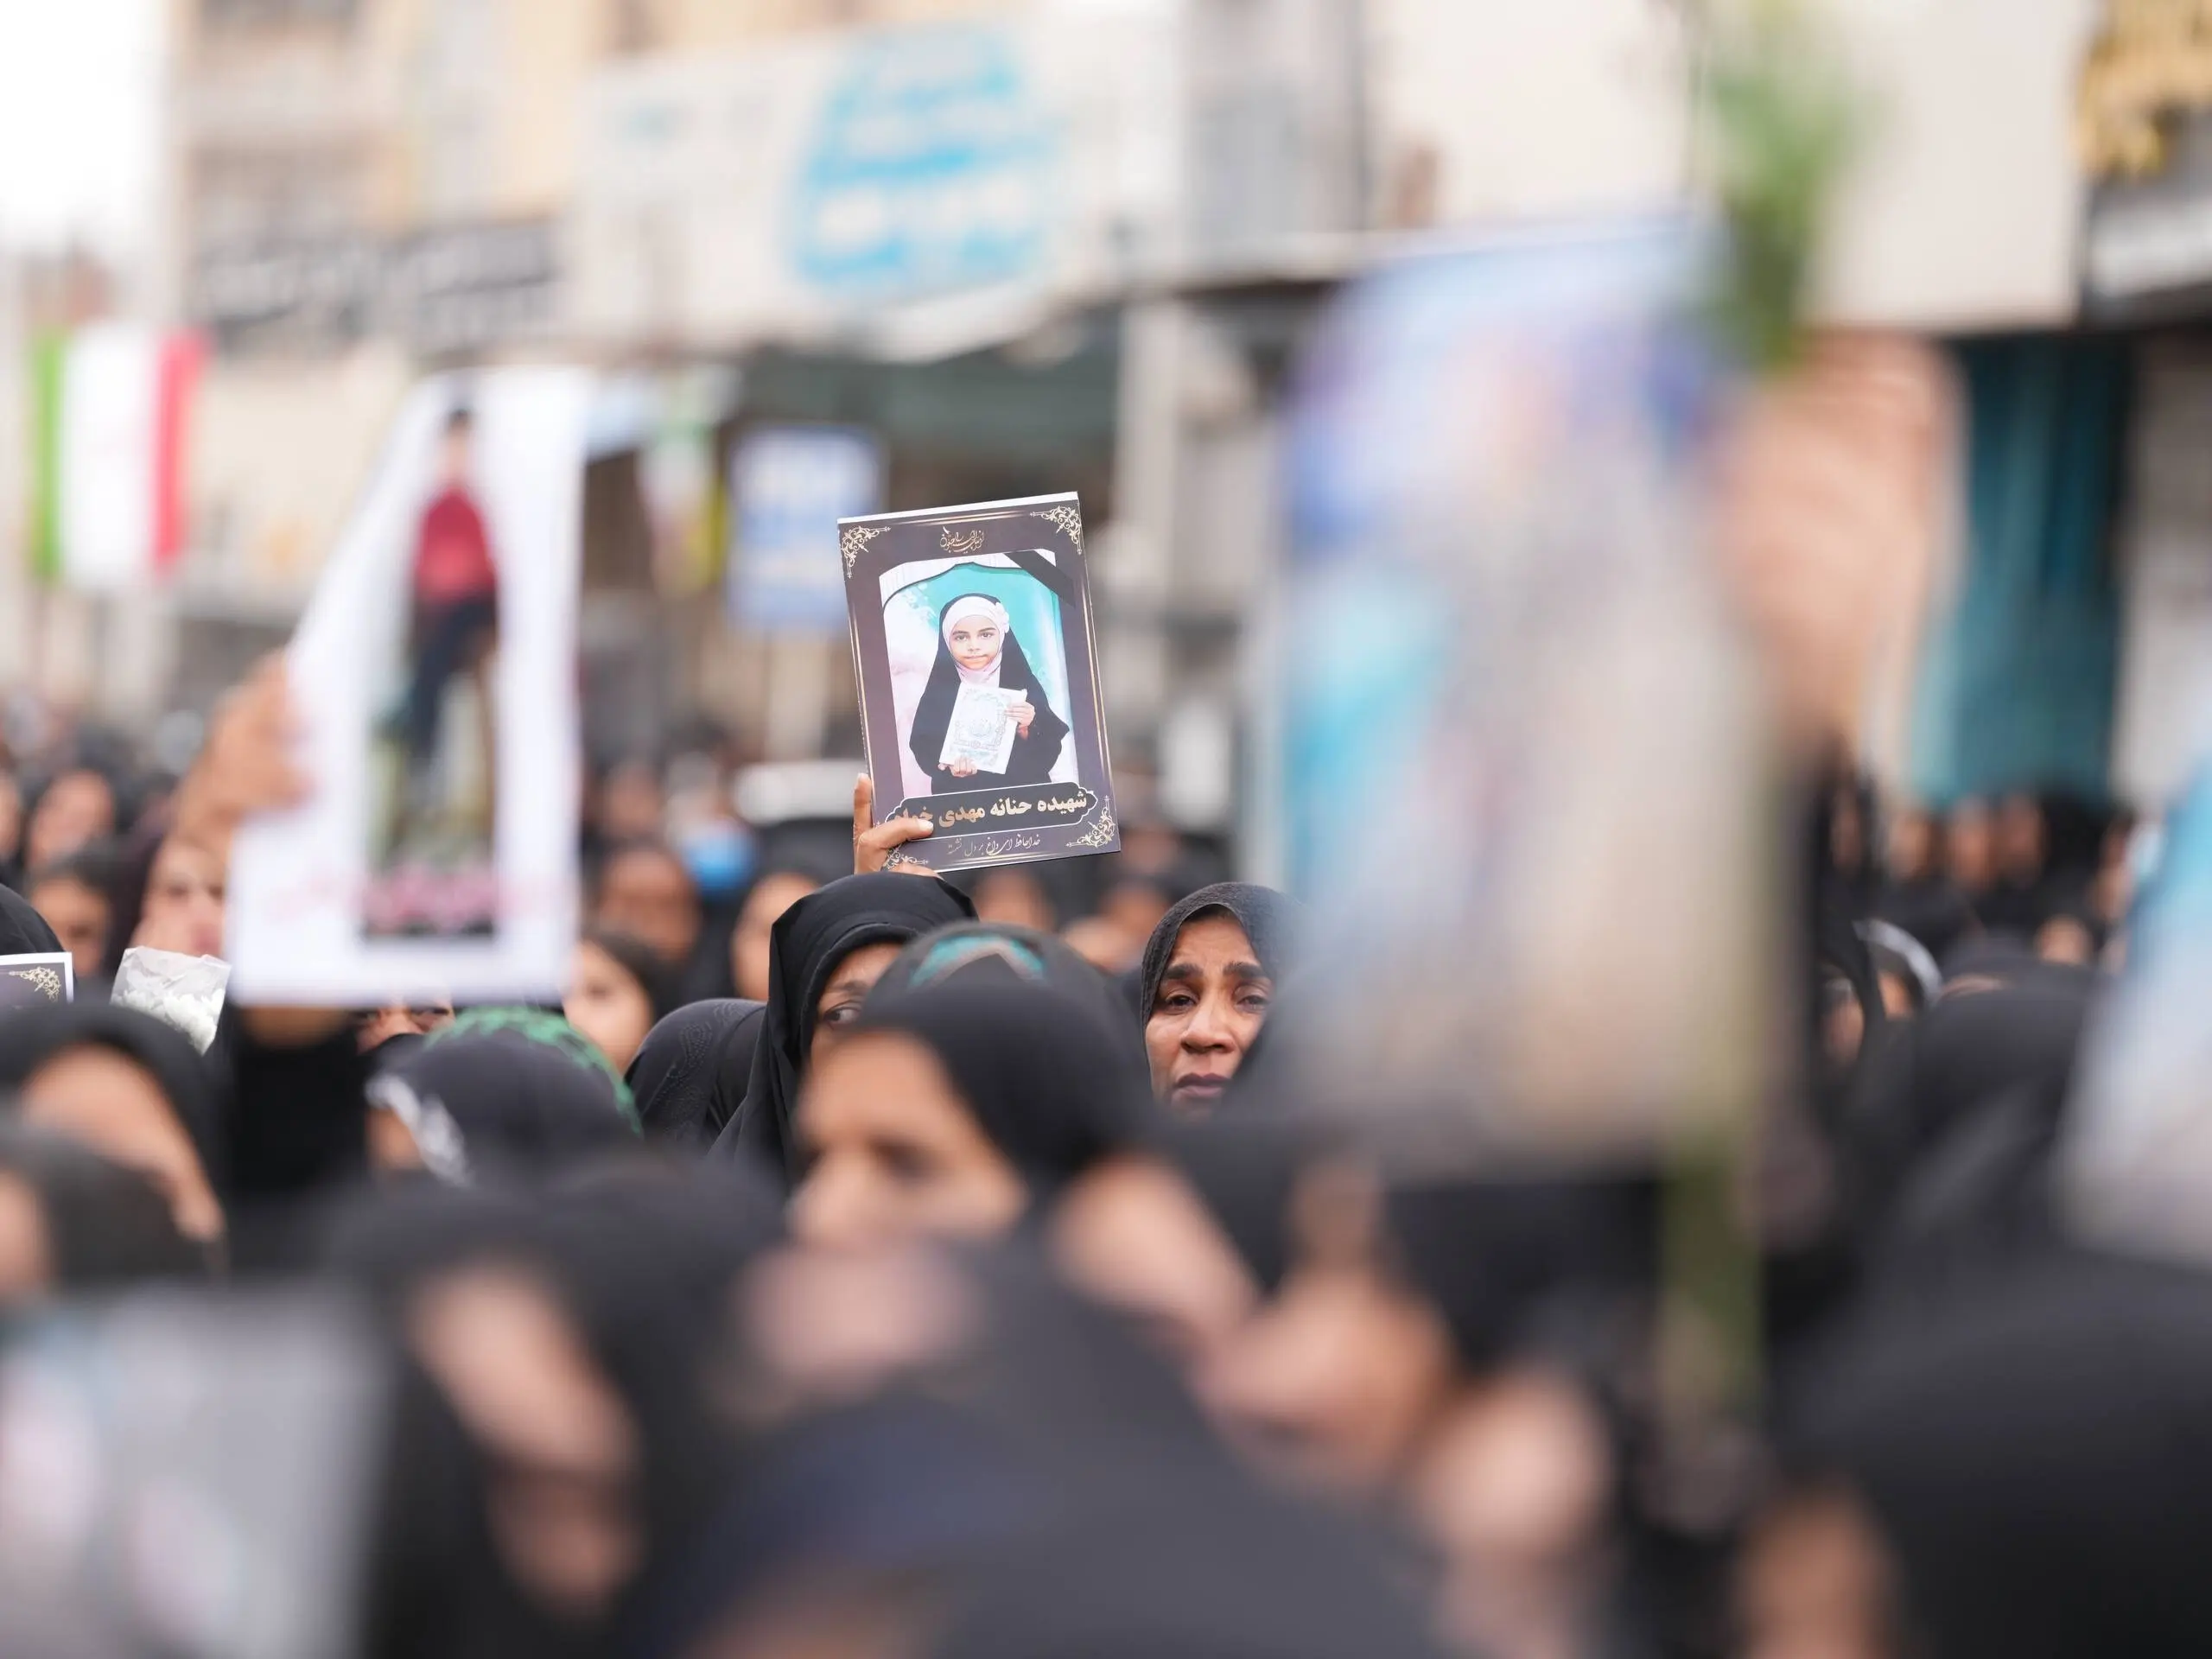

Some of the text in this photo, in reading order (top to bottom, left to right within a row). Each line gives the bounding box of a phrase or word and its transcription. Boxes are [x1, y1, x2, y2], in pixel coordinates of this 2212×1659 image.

[989, 797, 1033, 817] حنانه
[1038, 791, 1087, 815] شهیده
[938, 805, 986, 828] مهدی
